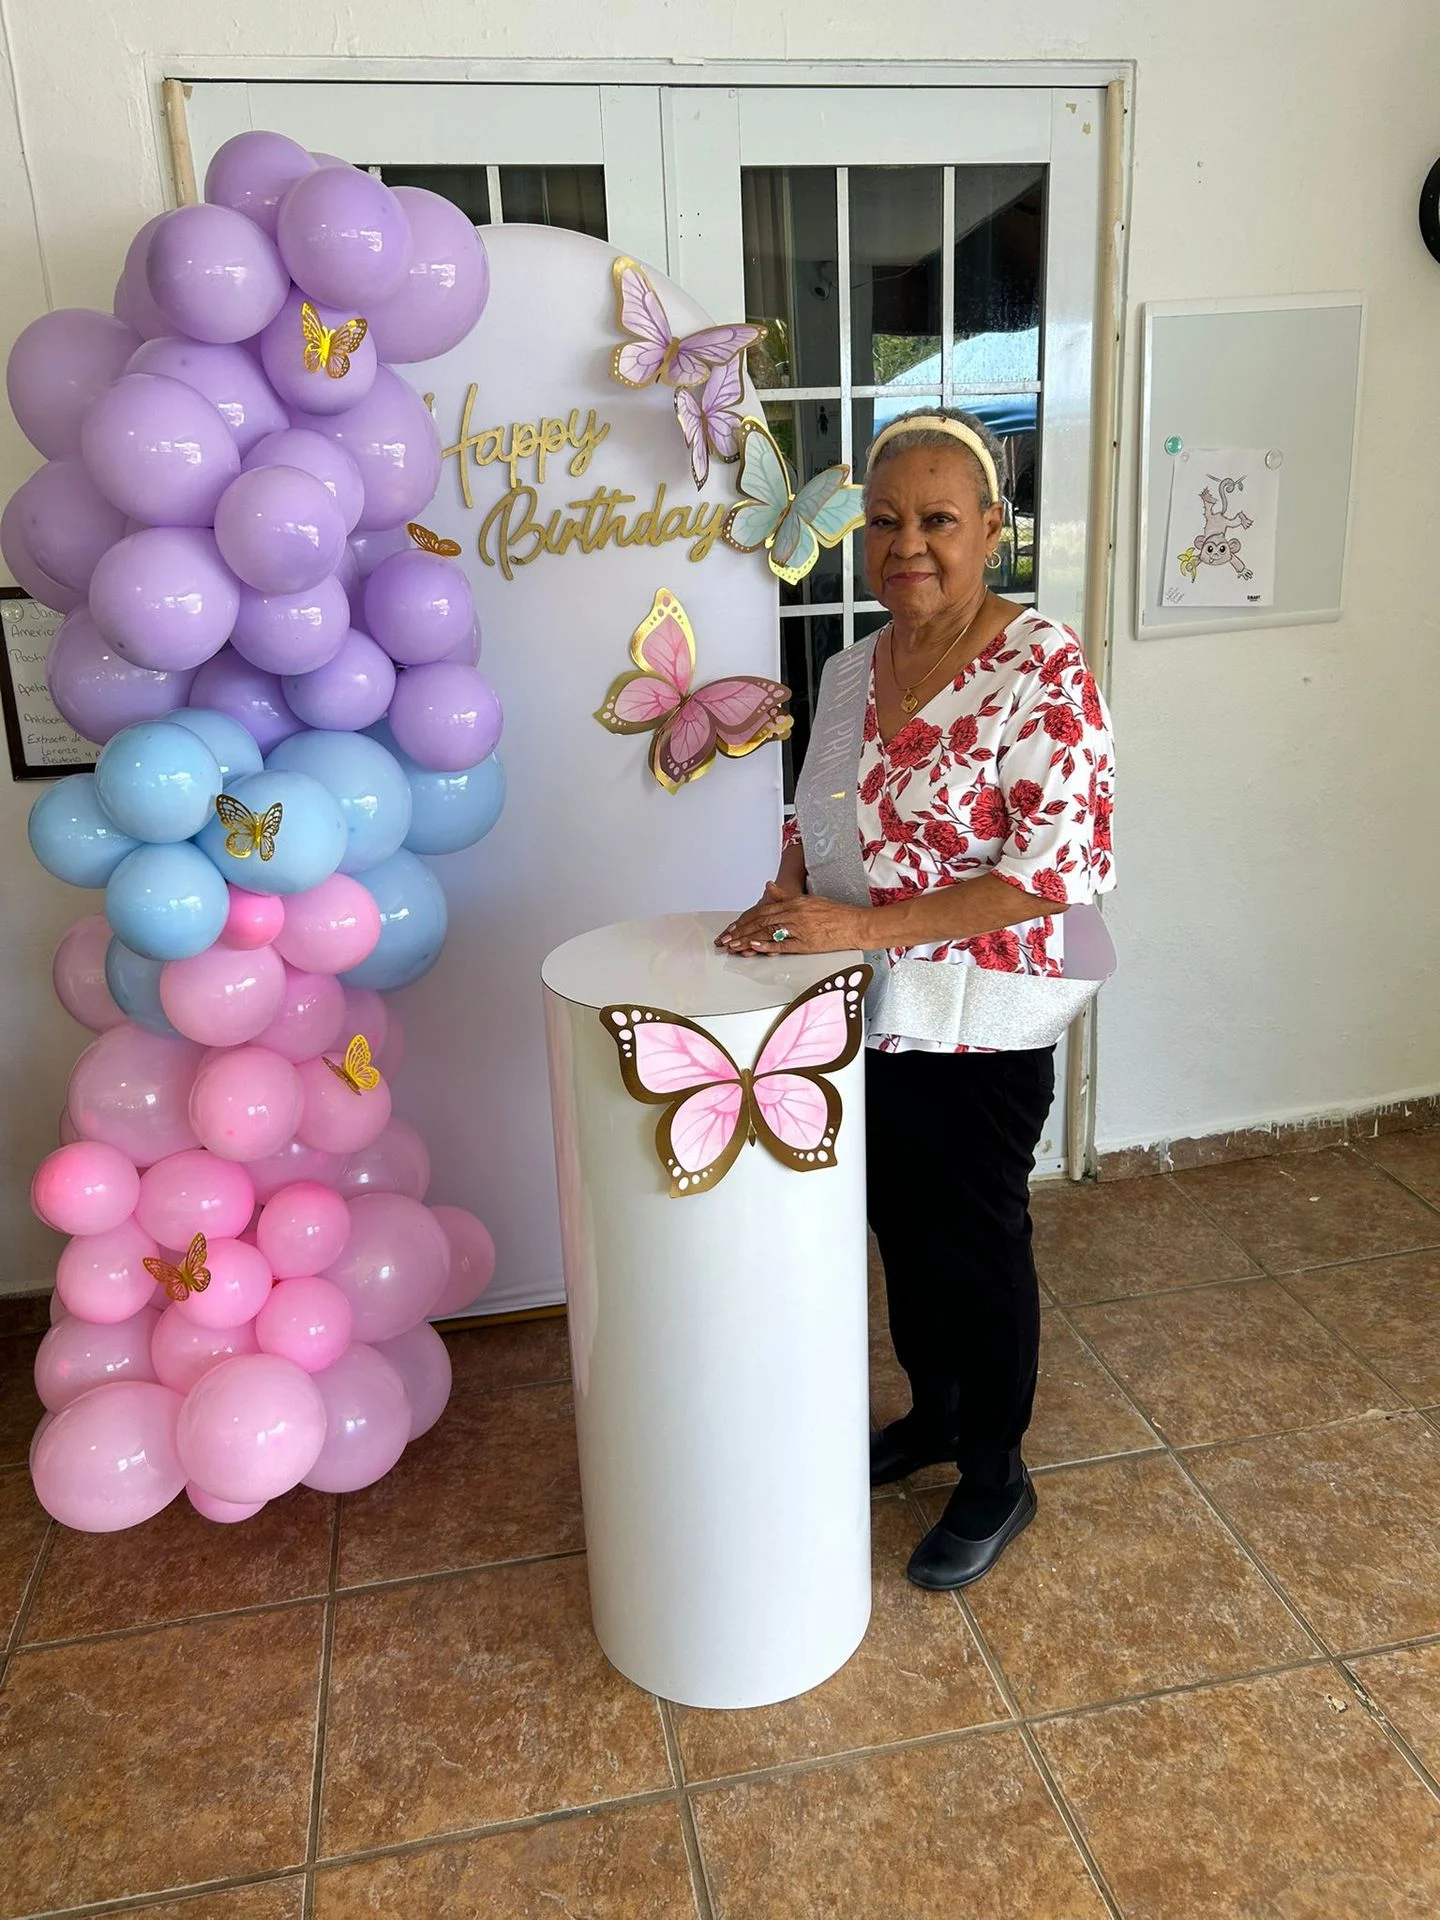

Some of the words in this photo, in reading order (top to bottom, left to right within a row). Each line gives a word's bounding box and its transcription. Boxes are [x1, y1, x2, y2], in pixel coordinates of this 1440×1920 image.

[424, 383, 611, 508] Happy
[478, 478, 726, 581] Birthday
[27, 733, 68, 744] Extracto
